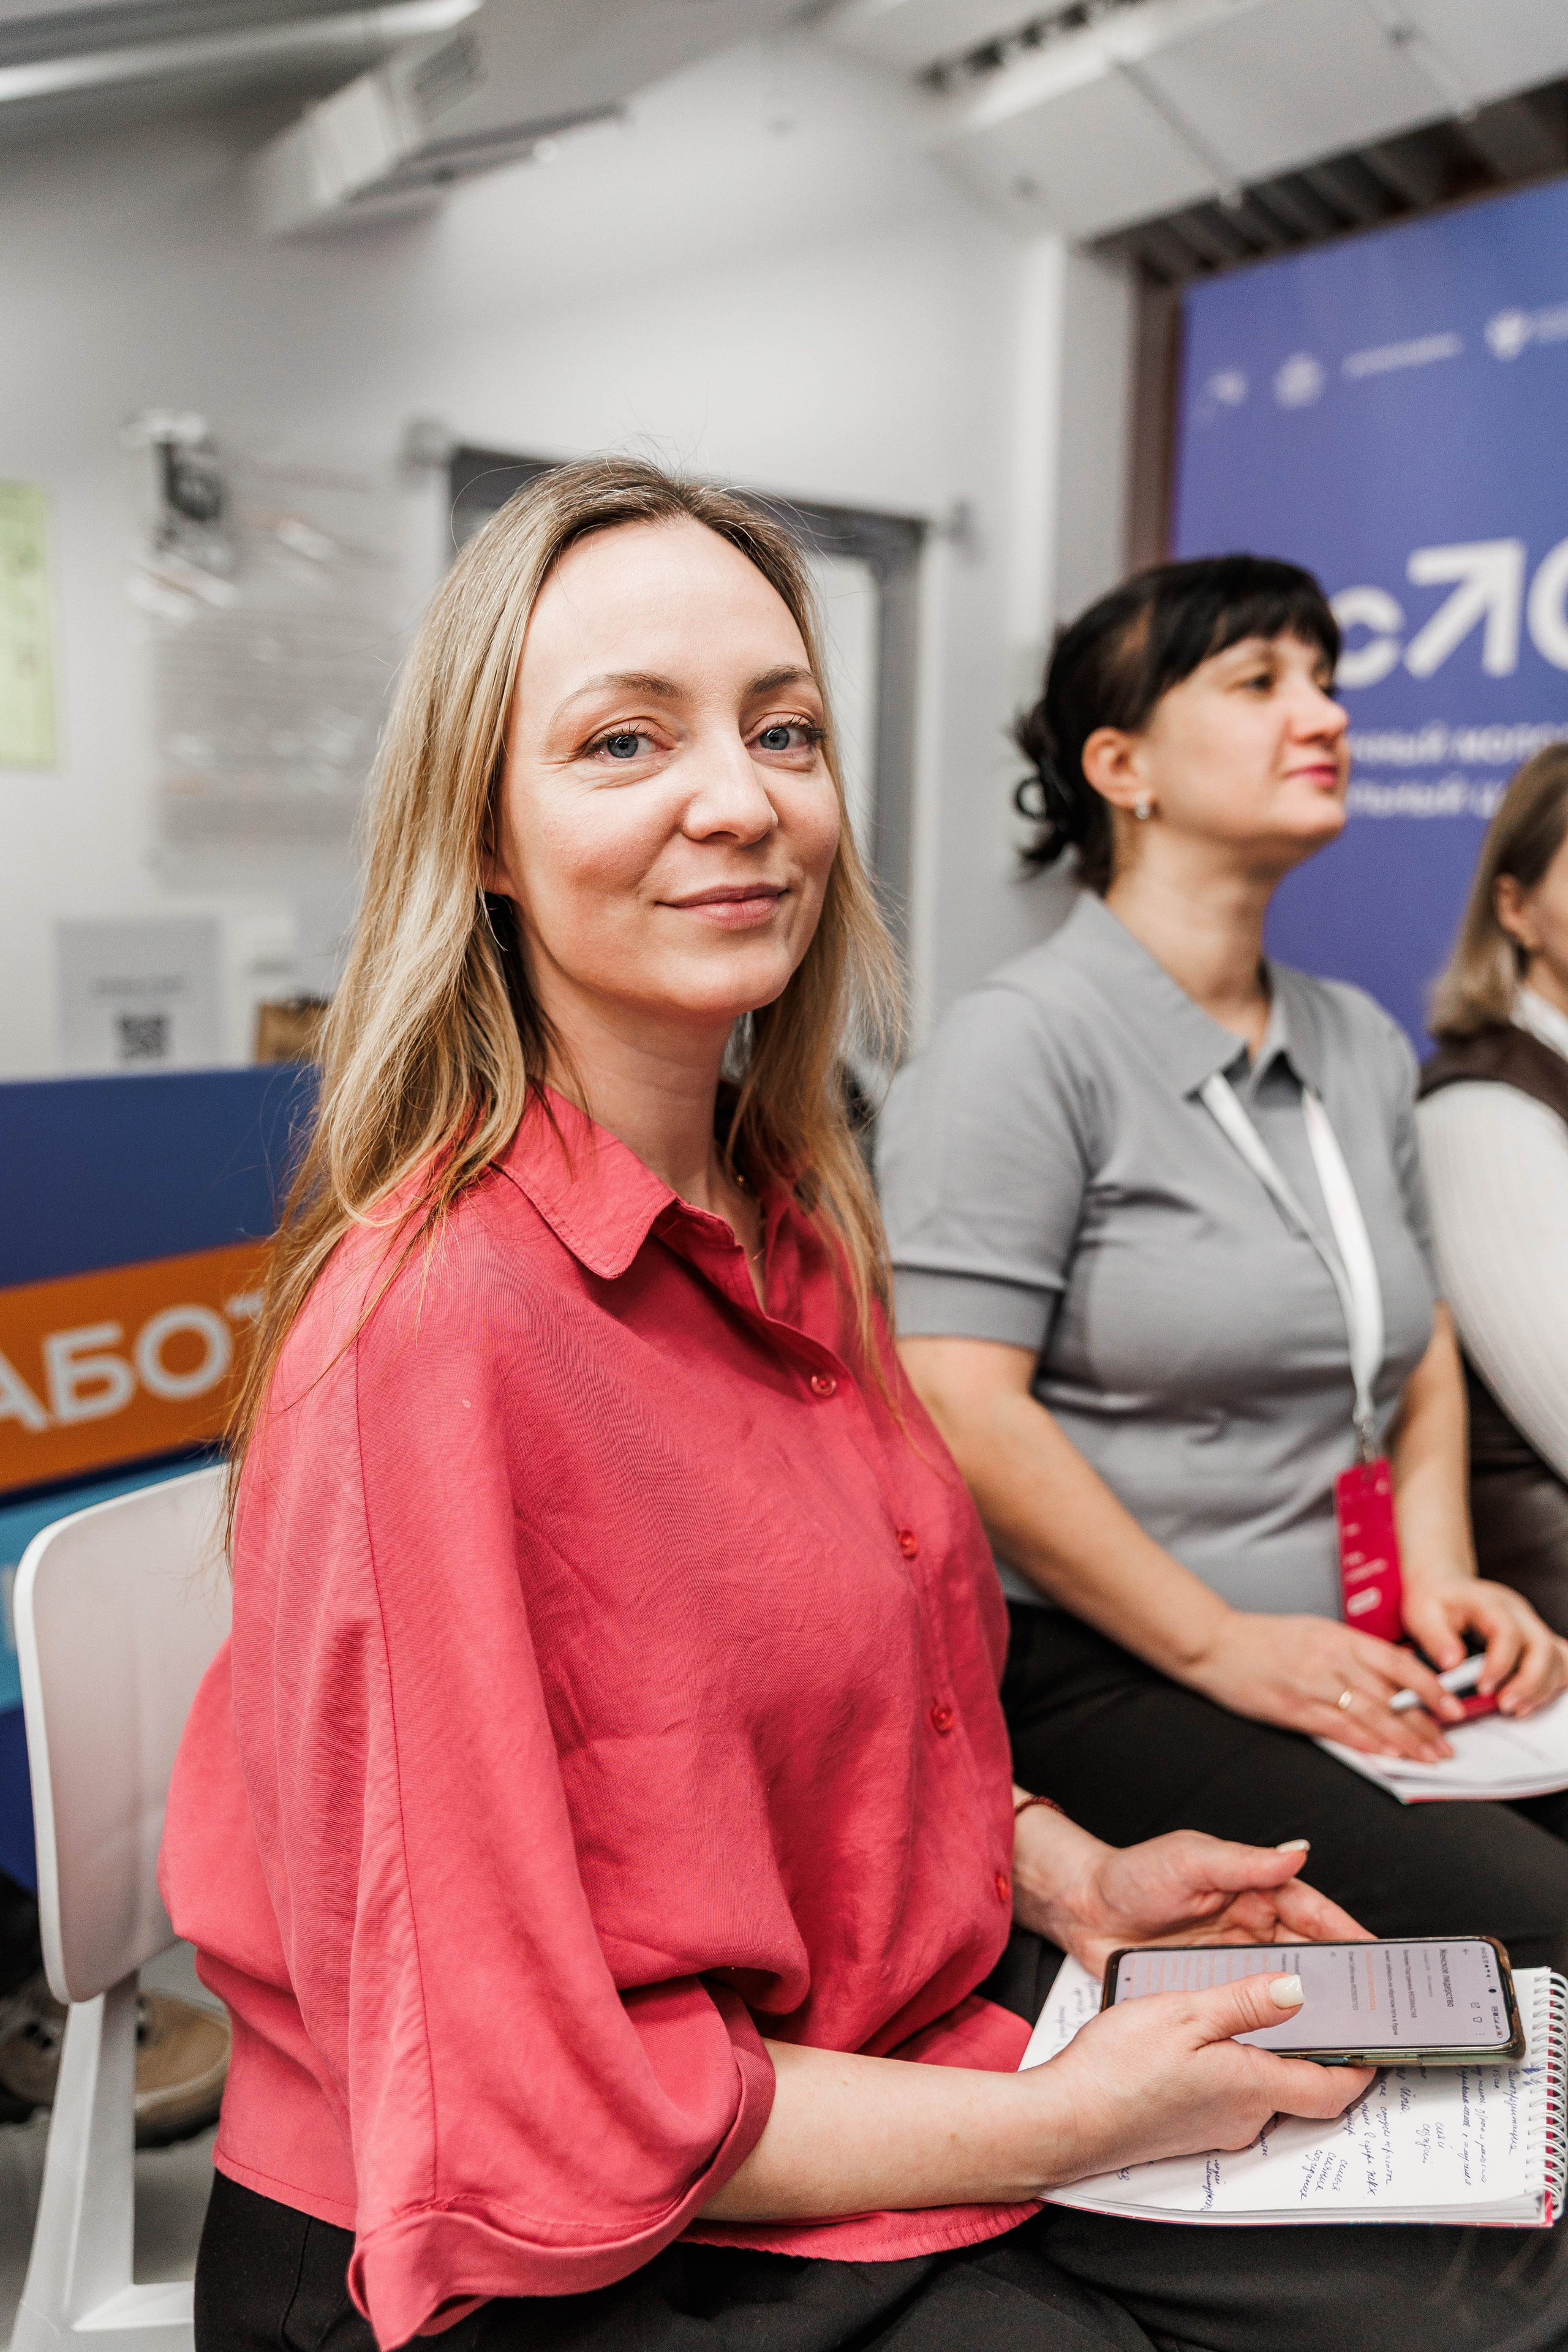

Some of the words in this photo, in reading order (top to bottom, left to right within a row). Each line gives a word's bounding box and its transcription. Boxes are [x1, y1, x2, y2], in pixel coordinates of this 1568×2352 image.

[1443, 1975, 1455, 2008] лидерство
[1300, 2149, 1323, 2201] созидание
[1314, 2152, 1336, 2192] сияние
